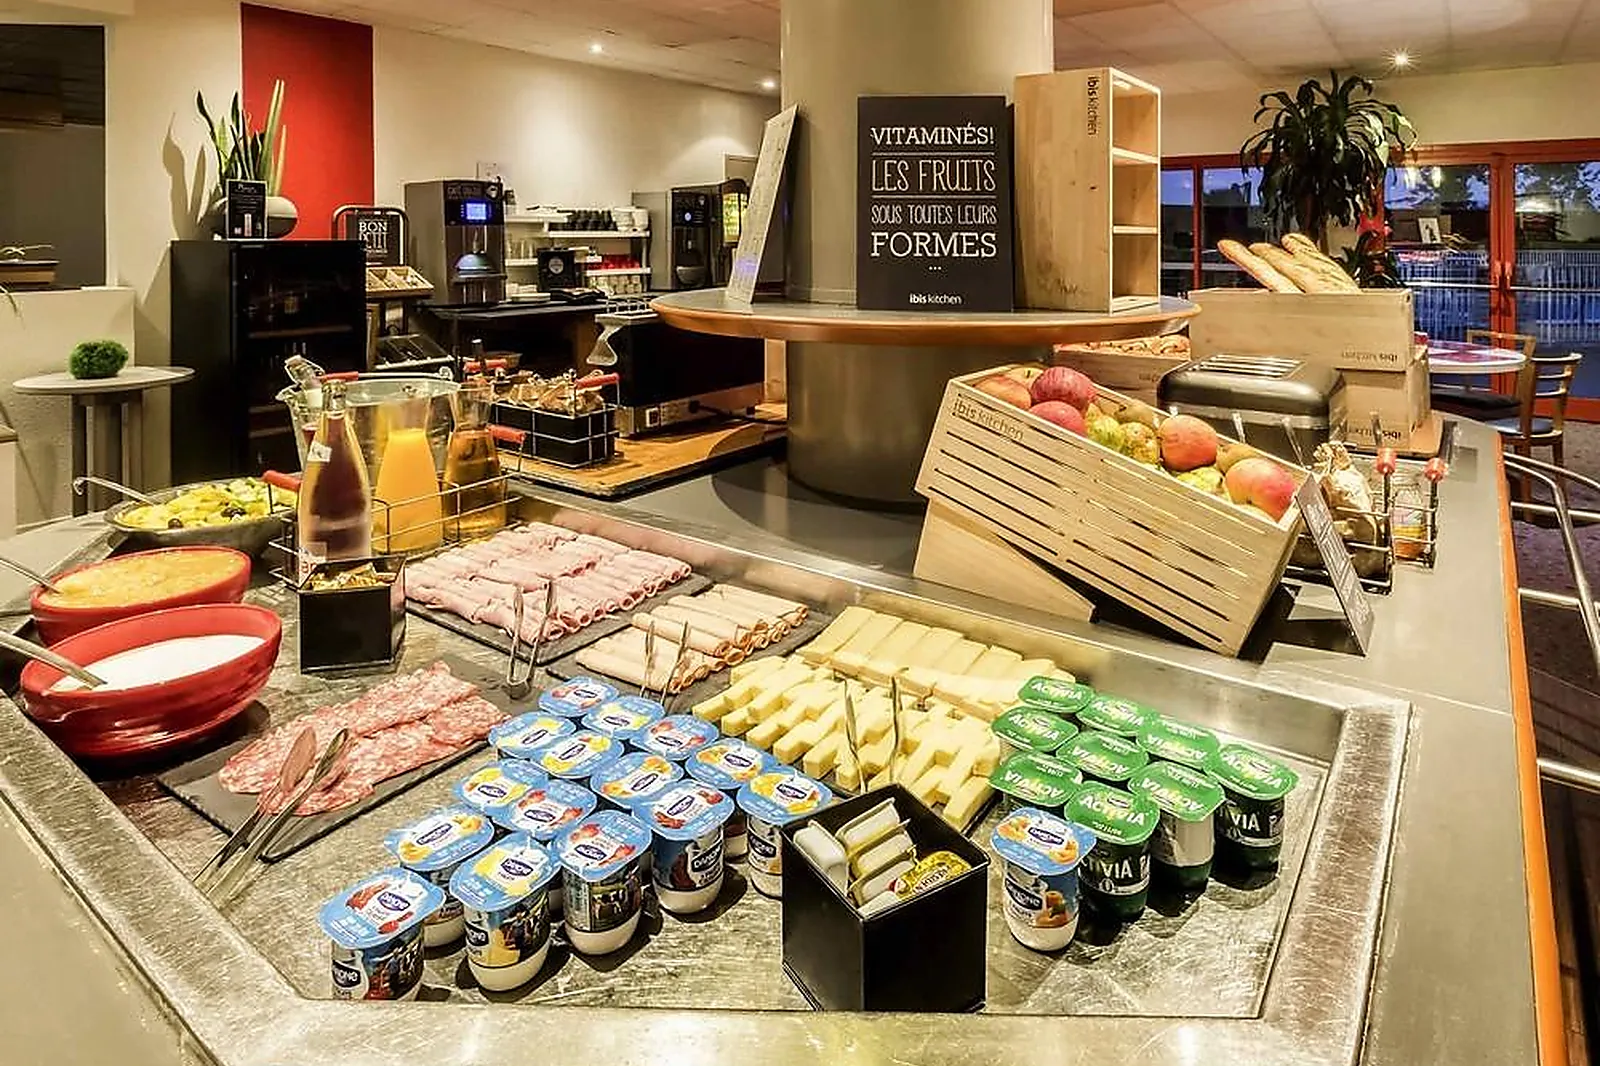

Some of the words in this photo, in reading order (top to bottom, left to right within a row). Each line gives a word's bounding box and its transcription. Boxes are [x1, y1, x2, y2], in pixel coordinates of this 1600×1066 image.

[870, 121, 994, 145] VITAMINÉS!
[872, 160, 909, 191] LES
[918, 160, 996, 191] FRUITS
[359, 221, 387, 232] BON
[871, 204, 903, 224] SOUS
[907, 204, 953, 224] TOUTES
[957, 204, 997, 225] LEURS
[871, 231, 997, 258] FORMES
[909, 293, 927, 304] ibis
[928, 293, 962, 304] kitchen
[953, 399, 977, 419] ibis
[979, 410, 1024, 440] kitchen
